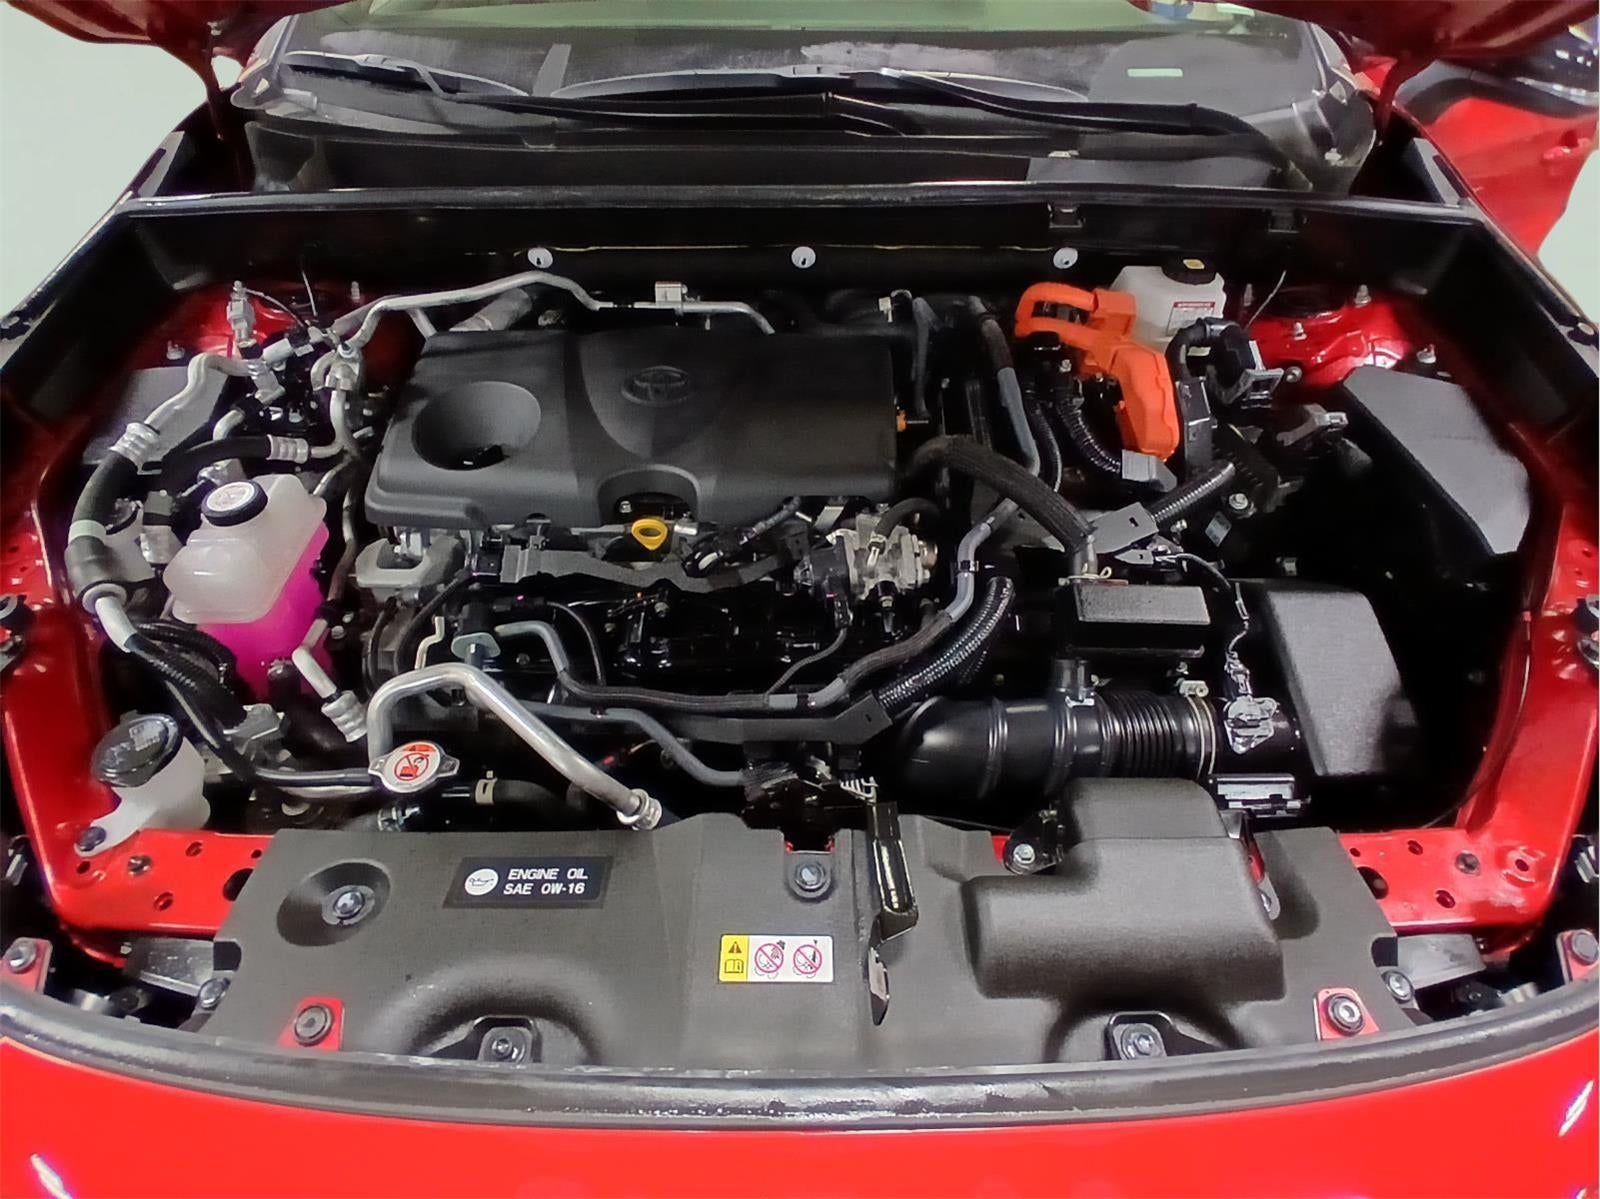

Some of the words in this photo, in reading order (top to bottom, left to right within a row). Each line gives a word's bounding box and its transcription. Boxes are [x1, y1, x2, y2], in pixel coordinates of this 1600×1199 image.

[507, 868, 560, 880] ENGINE
[566, 868, 588, 880] OIL
[503, 883, 534, 895] SAE
[540, 883, 586, 895] 0W-16
